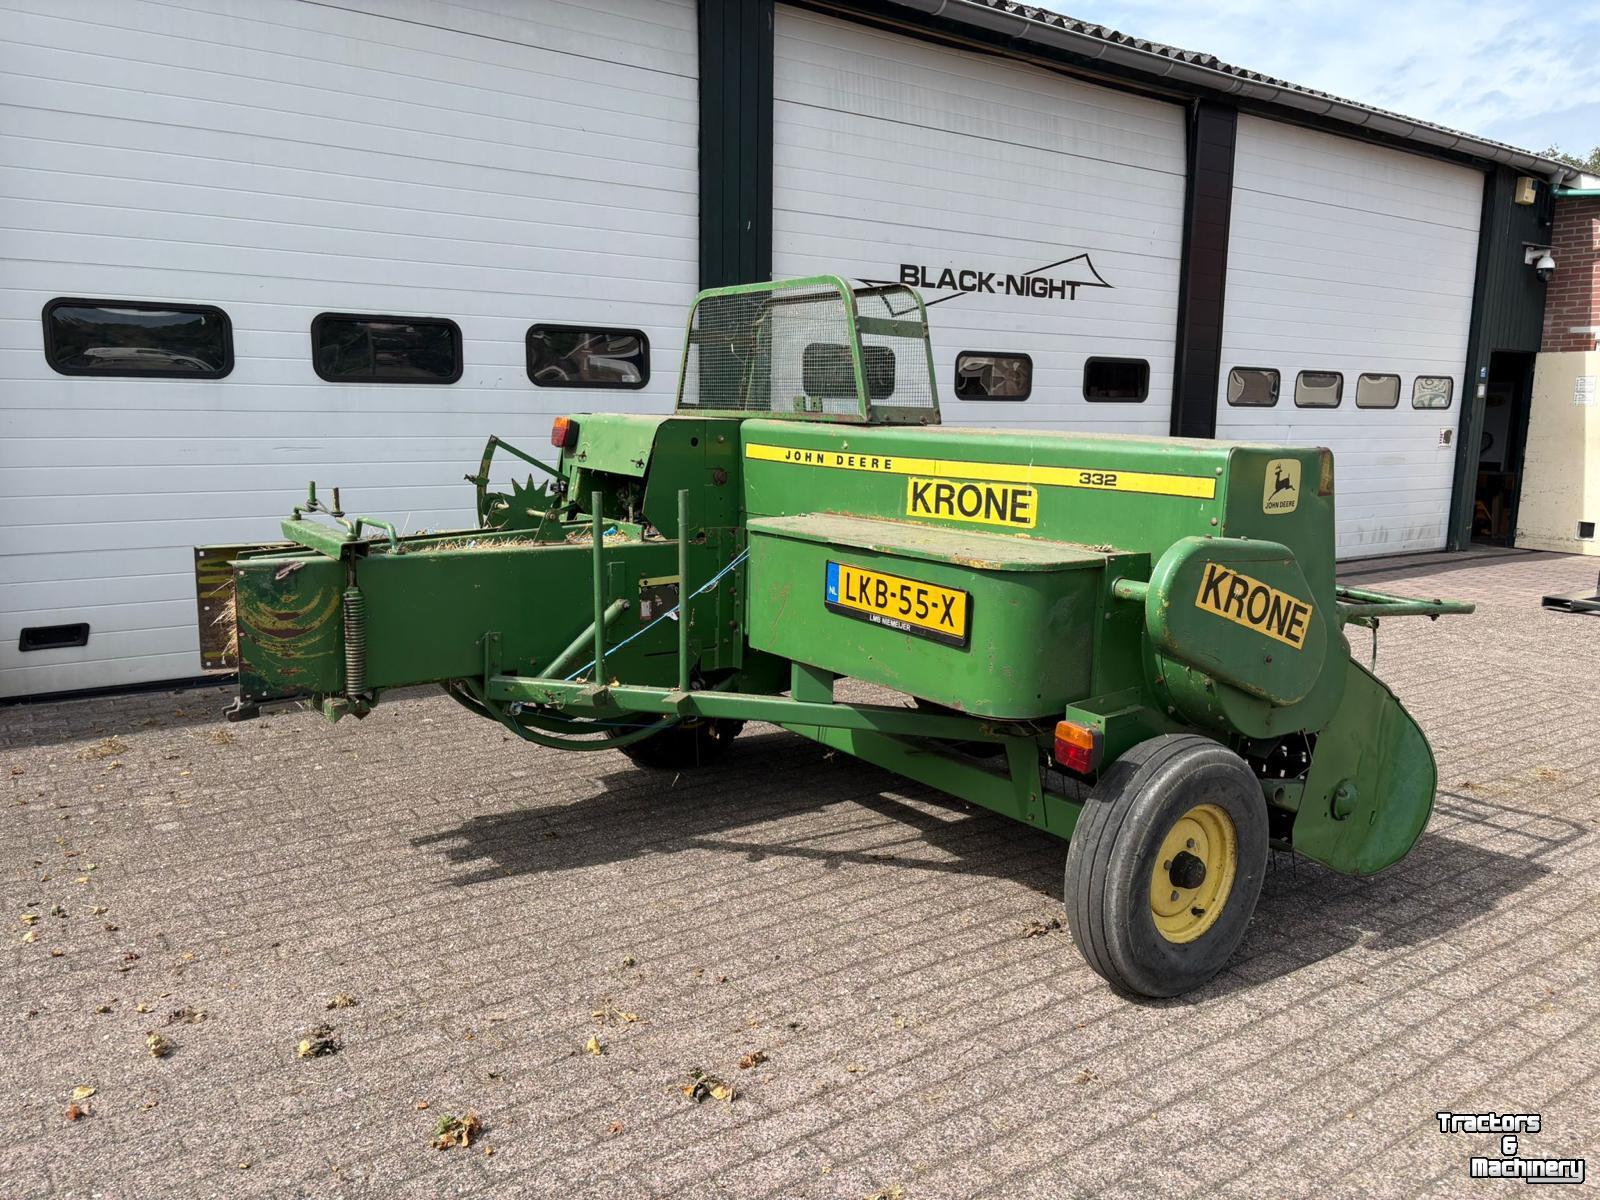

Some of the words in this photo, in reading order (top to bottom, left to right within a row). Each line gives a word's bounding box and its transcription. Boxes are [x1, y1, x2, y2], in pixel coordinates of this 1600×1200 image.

[900, 264, 1081, 300] BLACK-NIGHT
[785, 450, 824, 464] JOHN
[836, 455, 892, 470] DEERE
[1079, 472, 1117, 487] 332
[912, 481, 1032, 523] KRONE
[1265, 501, 1279, 509] JOHN
[1280, 500, 1295, 508] DEERE
[828, 586, 838, 596] NL
[845, 572, 955, 627] LKB-55-X
[1201, 565, 1308, 643] KRONE
